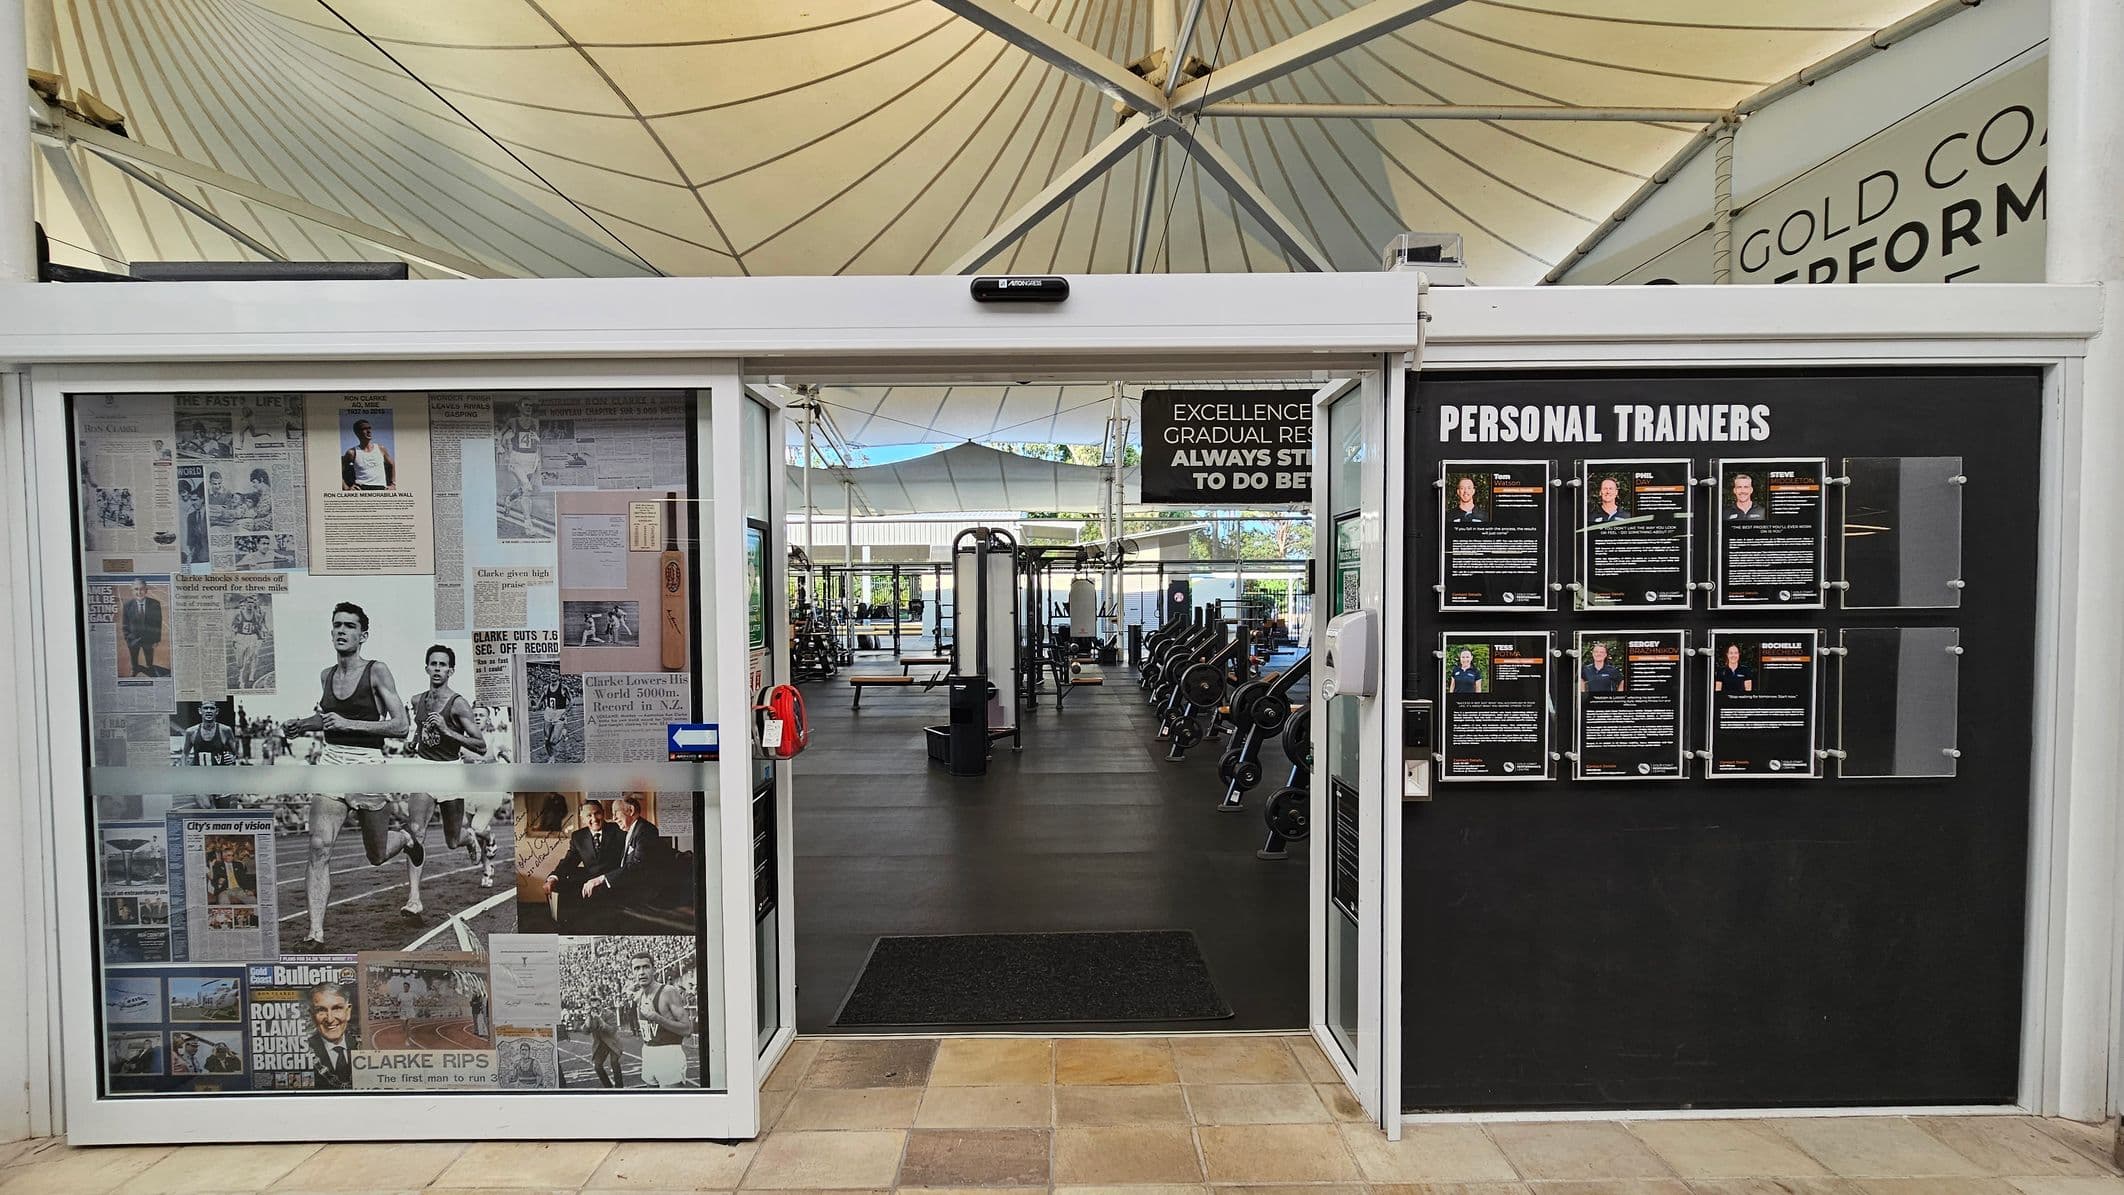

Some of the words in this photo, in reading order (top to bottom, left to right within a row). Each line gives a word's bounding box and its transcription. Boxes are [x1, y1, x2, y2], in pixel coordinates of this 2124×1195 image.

[1740, 170, 1899, 273] GOLD
[174, 395, 200, 407] THE
[463, 401, 490, 410] RIVALS
[1173, 403, 1313, 421] EXCELLENCE
[1439, 405, 1603, 443] PERSONAL
[1613, 404, 1771, 442] TRAINERS
[1163, 426, 1273, 444] GRADUAL
[1171, 449, 1272, 467] ALWAYS
[177, 467, 202, 477] WORLD
[1193, 472, 1226, 490] TO
[1232, 472, 1269, 490] DO
[241, 574, 271, 582] seconds
[477, 569, 504, 578] Clarke
[507, 570, 528, 579] given
[532, 569, 549, 579] high
[176, 584, 199, 592] world
[202, 584, 228, 592] record
[230, 584, 243, 592] for
[245, 584, 266, 592] three
[268, 584, 289, 592] miles
[501, 581, 526, 590] praise
[103, 595, 117, 604] BE
[473, 630, 509, 643] CLARKE
[513, 630, 538, 641] CUTS
[475, 643, 496, 656] SEC.
[500, 643, 518, 654] OFF
[525, 642, 559, 654] RECORD
[585, 676, 623, 688] Clarke
[626, 675, 668, 687] Lowers
[669, 674, 689, 685] His
[593, 688, 631, 699] World
[636, 688, 680, 699] 5000m.
[593, 701, 634, 712] Record
[641, 701, 653, 711] in
[660, 699, 684, 710] N.Z.
[187, 821, 211, 832] City's
[212, 823, 232, 831] man
[233, 821, 243, 832] of
[245, 821, 271, 831] vision
[250, 967, 268, 976] Gold
[250, 975, 272, 985] Coast
[250, 1002, 301, 1020] RON'S
[251, 1019, 308, 1037] FLAME
[252, 1036, 310, 1053] BURNS
[253, 1053, 315, 1071] BRIGHT
[352, 1053, 434, 1070] CLARKE
[443, 1053, 490, 1069] RIPS
[377, 1074, 397, 1083] The
[402, 1074, 423, 1083] first
[427, 1075, 449, 1083] man
[454, 1074, 465, 1082] to
